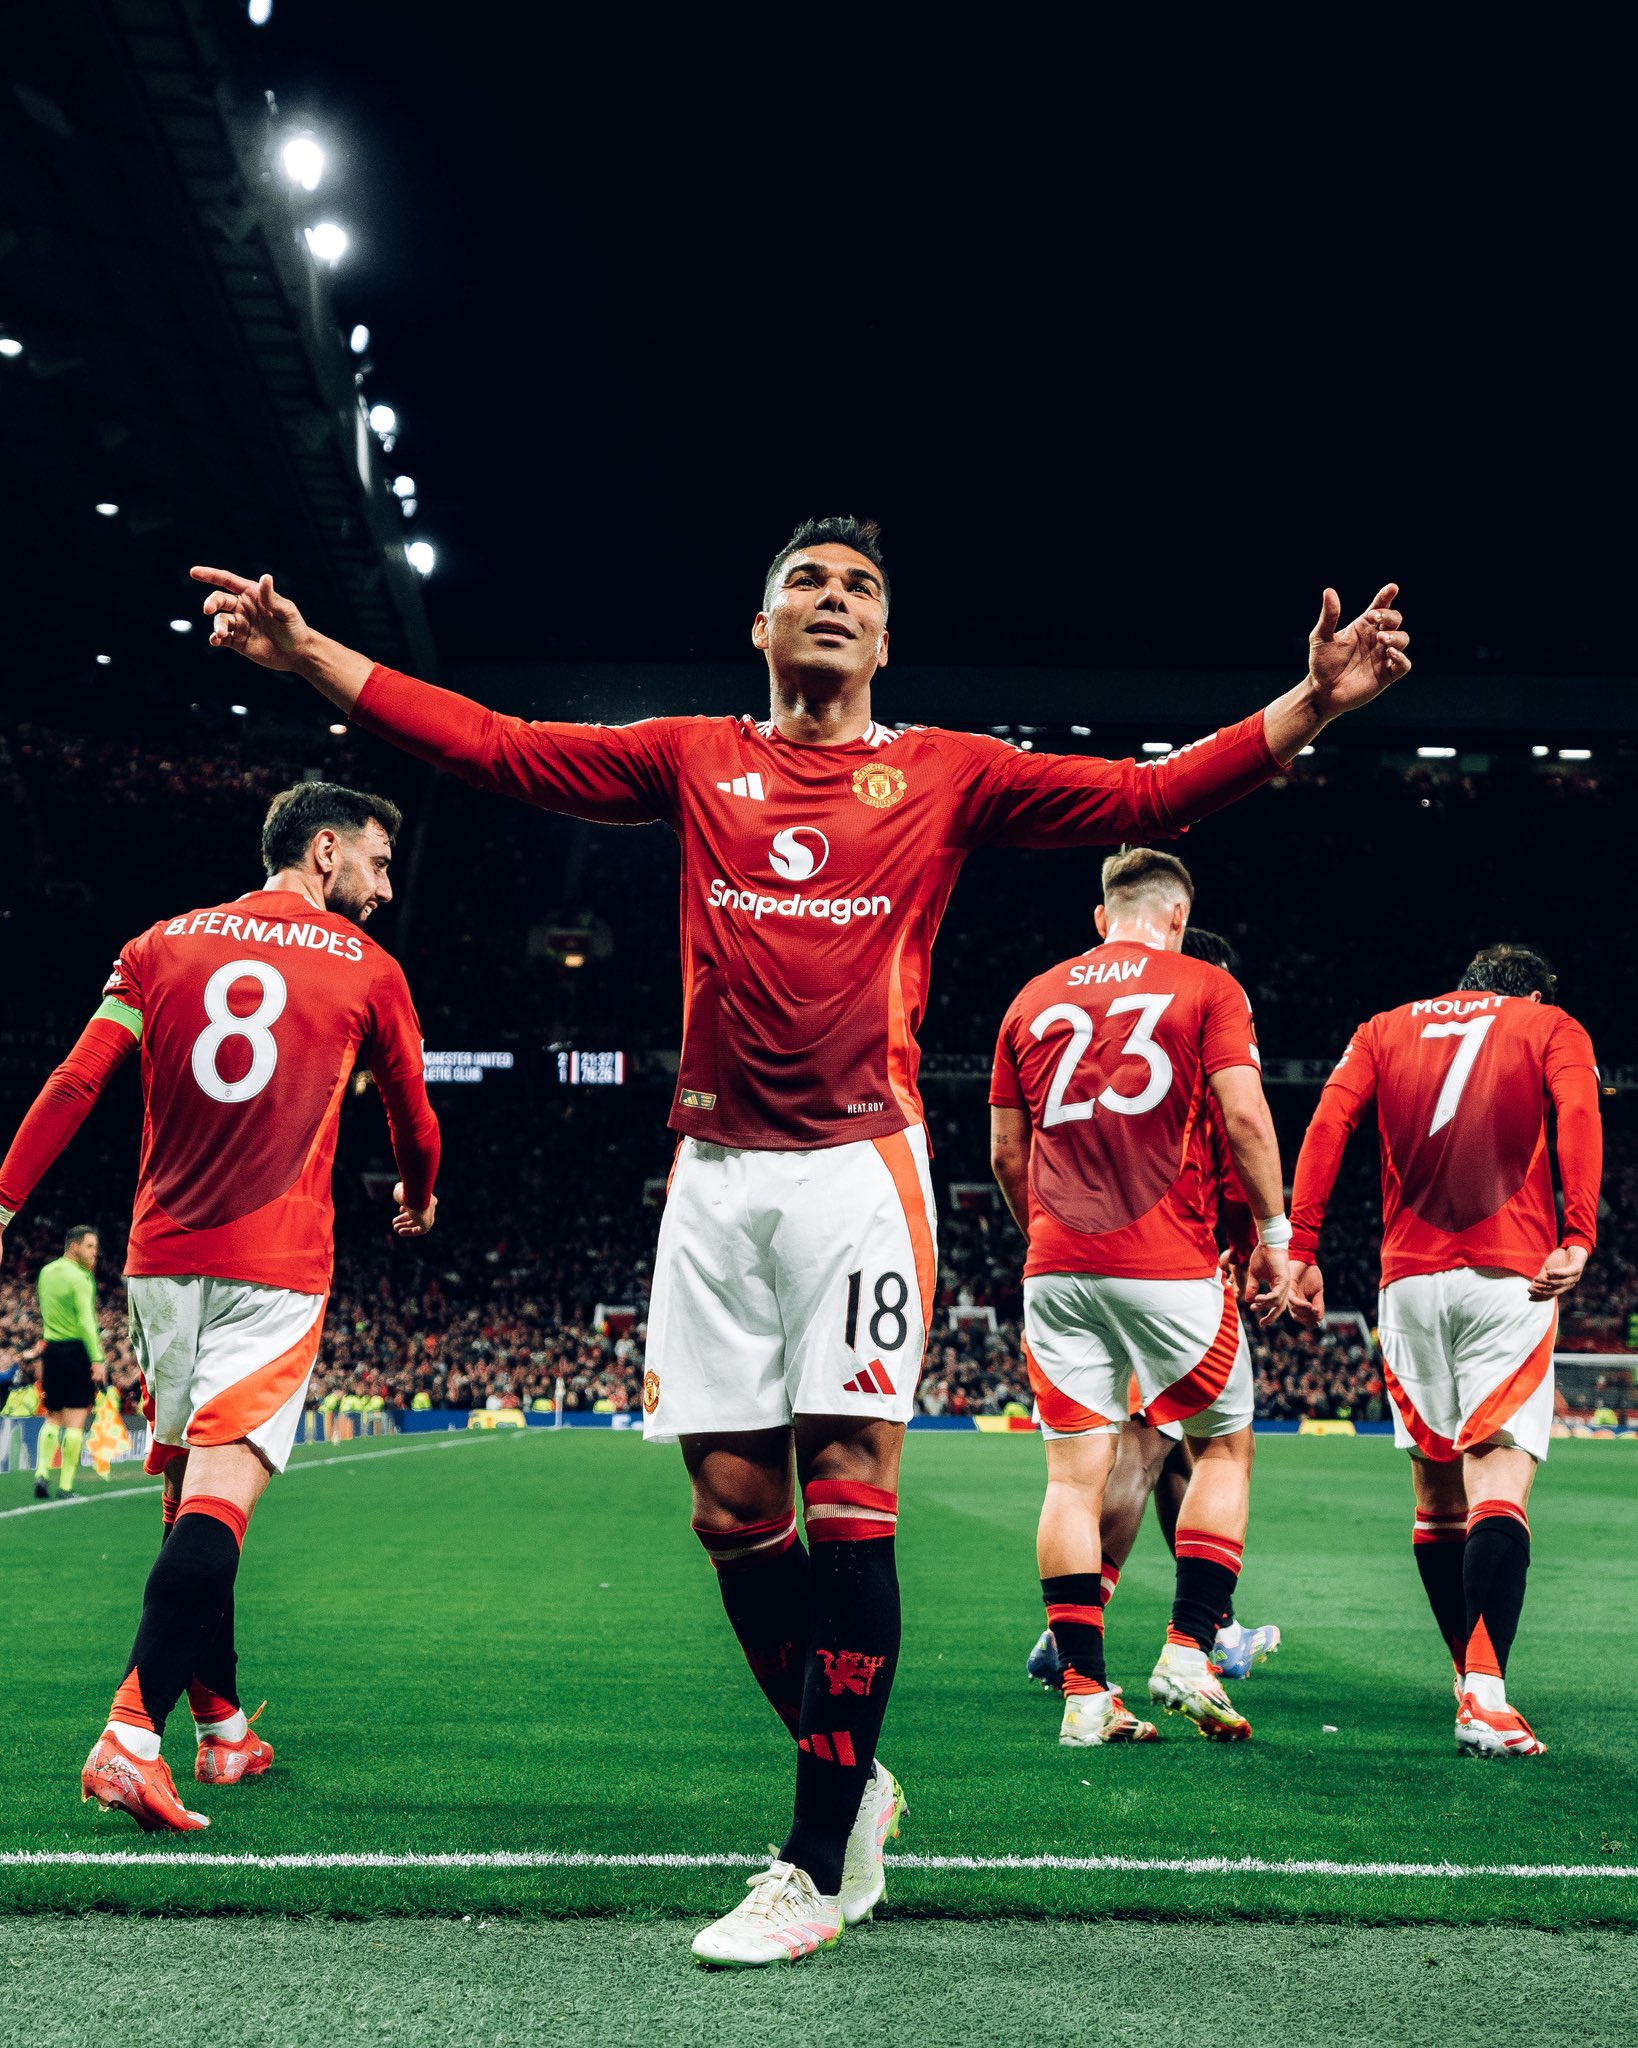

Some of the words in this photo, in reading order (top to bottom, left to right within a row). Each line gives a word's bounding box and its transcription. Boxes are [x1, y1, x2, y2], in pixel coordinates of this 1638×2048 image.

[857, 763, 900, 780] MANCHESTER
[866, 796, 897, 805] UNITED
[707, 878, 892, 926] Snapdragon
[164, 911, 364, 962] B.FERNANDES
[1067, 957, 1149, 987] SHAW
[1411, 995, 1511, 1017] MOUNT
[191, 959, 288, 1104] 8
[424, 1051, 473, 1067] CHESTER
[473, 1051, 514, 1069] UNITED
[557, 1051, 569, 1067] 2
[1028, 992, 1176, 1129] 23
[453, 1066, 484, 1082] CLUB
[1420, 1014, 1497, 1137] 7
[847, 1101, 885, 1114] HEAT.RDY
[843, 1268, 909, 1353] 18
